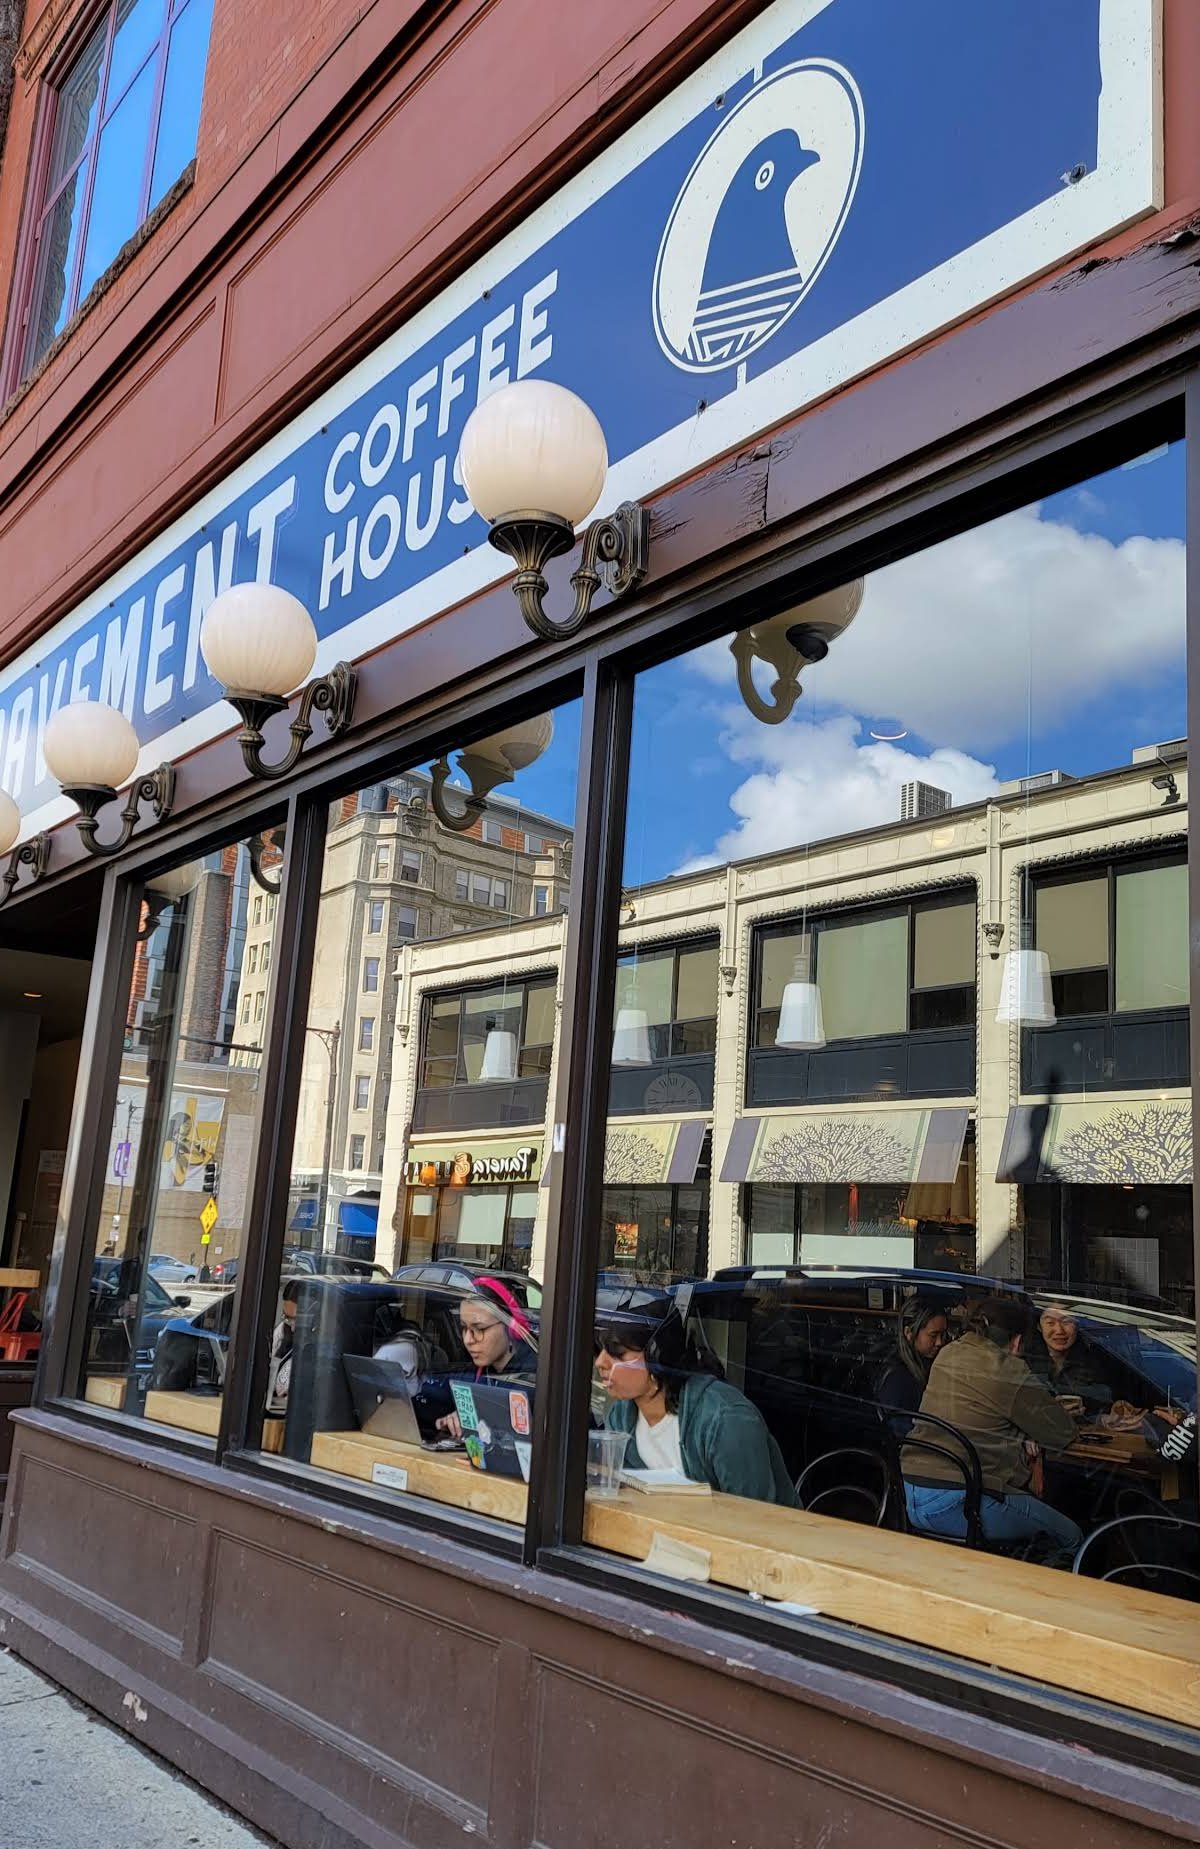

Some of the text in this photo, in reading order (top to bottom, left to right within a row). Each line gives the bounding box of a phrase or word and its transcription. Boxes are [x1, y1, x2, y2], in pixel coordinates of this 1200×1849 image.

[325, 269, 558, 514] COFFEE
[319, 450, 475, 612] HOUS
[0, 475, 296, 799] AVEMENT
[1161, 1424, 1195, 1461] HUS
